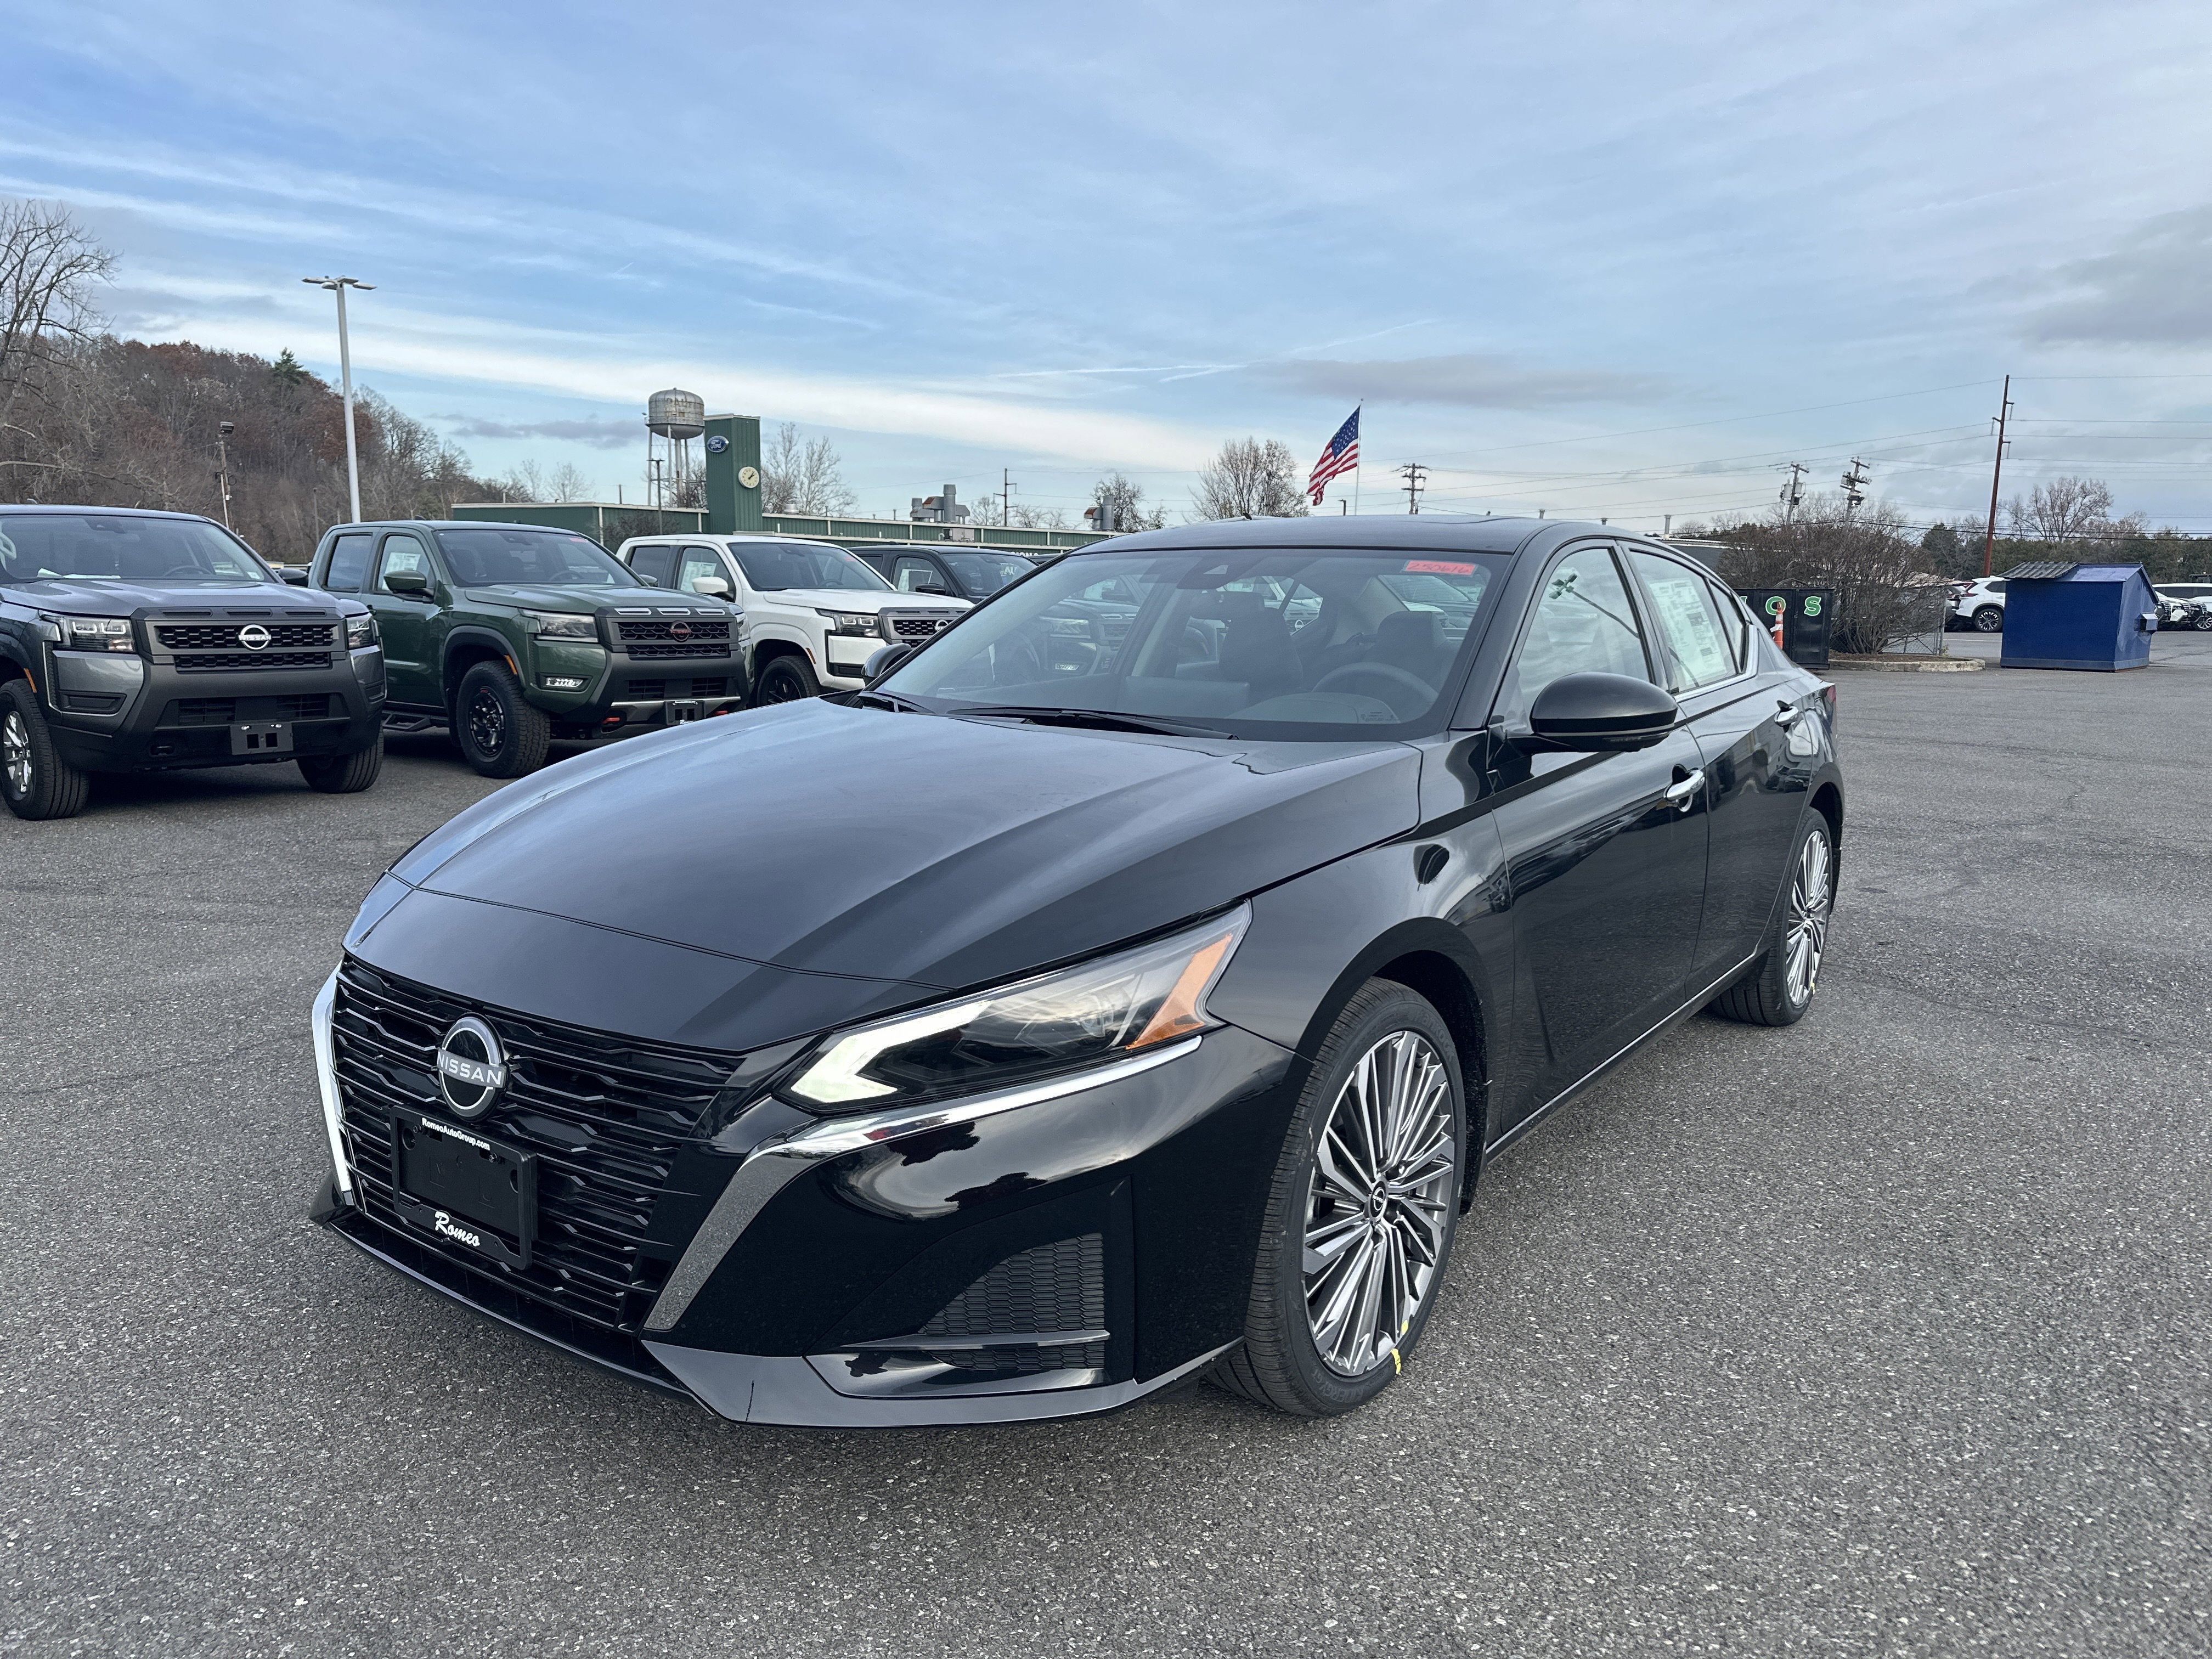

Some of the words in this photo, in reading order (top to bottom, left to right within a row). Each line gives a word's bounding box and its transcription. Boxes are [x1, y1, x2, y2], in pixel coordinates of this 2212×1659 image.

[437, 1051, 502, 1085] NISSAN
[422, 1117, 490, 1150] RomeoAutoGroup.com
[435, 1211, 480, 1247] Romeo
